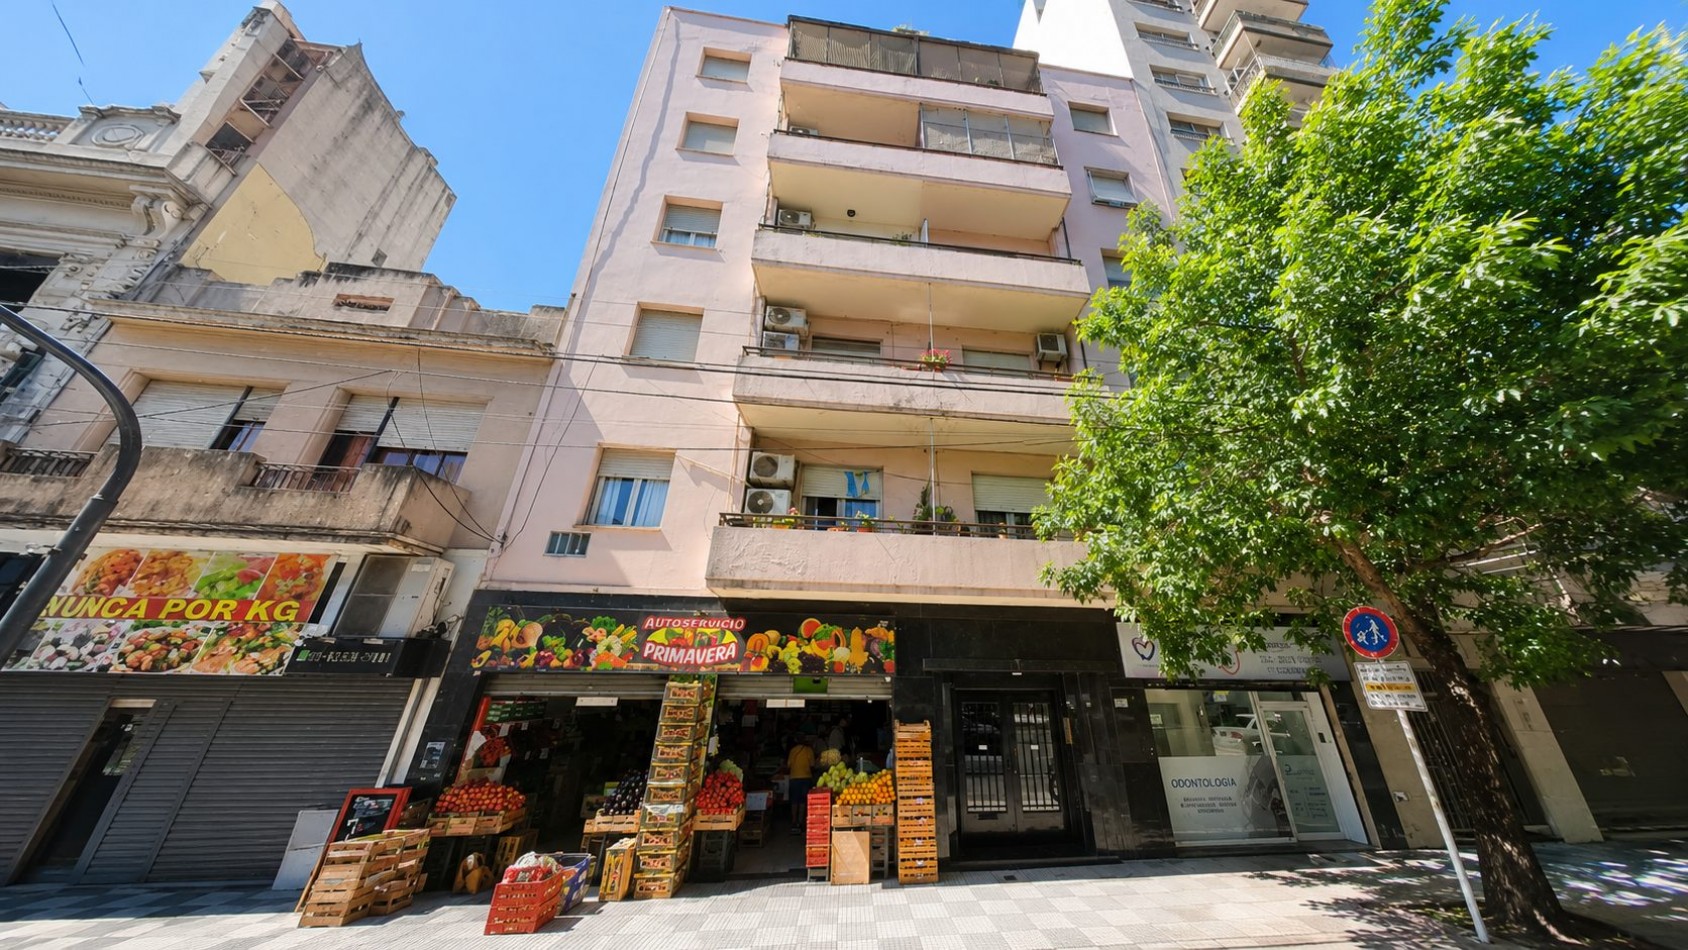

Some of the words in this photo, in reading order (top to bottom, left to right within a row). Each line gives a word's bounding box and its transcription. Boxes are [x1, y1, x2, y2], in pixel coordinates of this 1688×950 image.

[158, 598, 238, 621] POR
[244, 599, 300, 622] KG
[644, 617, 744, 630] AUTOSERVICIO
[643, 642, 736, 664] PRIMAVERA
